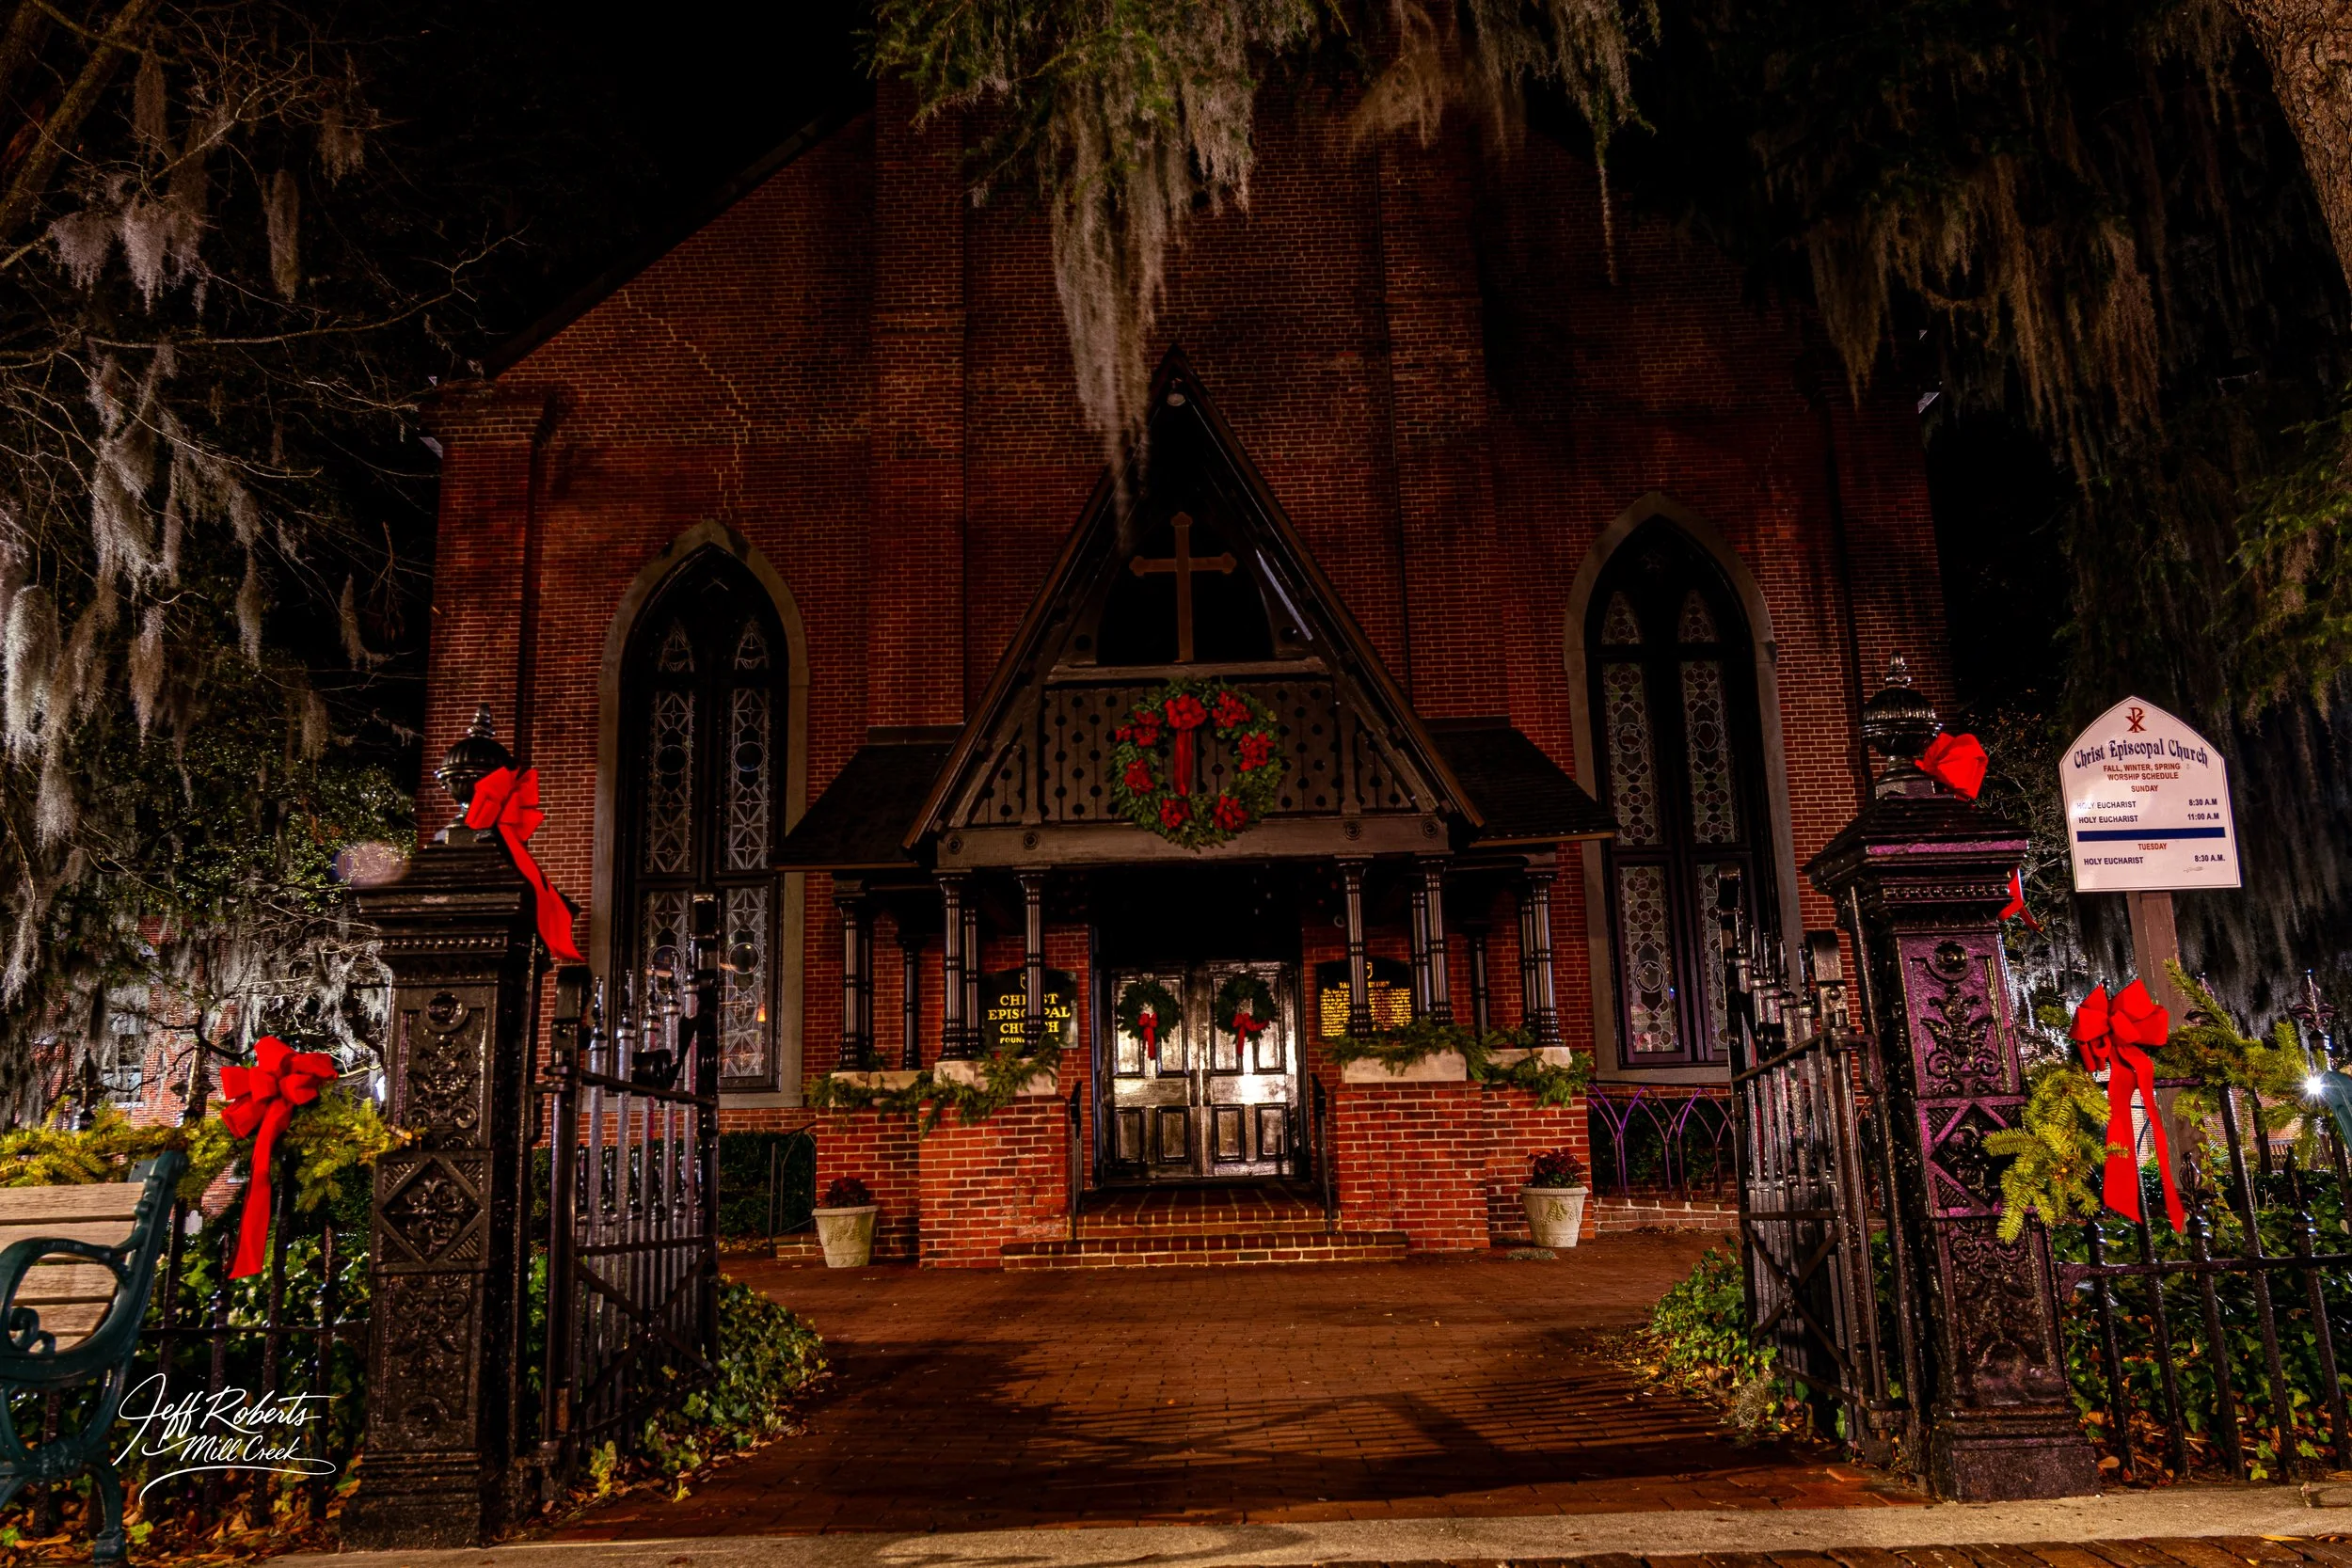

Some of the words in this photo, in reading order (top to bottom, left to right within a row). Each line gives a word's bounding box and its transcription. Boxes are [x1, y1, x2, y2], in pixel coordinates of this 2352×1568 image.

[2074, 744, 2106, 768] Christ
[2108, 738, 2165, 761] Episcopal
[2168, 739, 2208, 768] Church
[2096, 800, 2137, 809] EUCHARIST
[2188, 798, 2203, 806] 8:30
[2098, 815, 2138, 823] EUCHARIST
[2187, 813, 2205, 821] 11:00
[2104, 856, 2144, 865] EUCHARIST
[2194, 854, 2209, 863] 8:30
[2210, 853, 2226, 862] A.M.
[999, 993, 1059, 1006] CHT
[987, 1006, 1071, 1021] EPISCPAL
[999, 1021, 1059, 1035] CHUH
